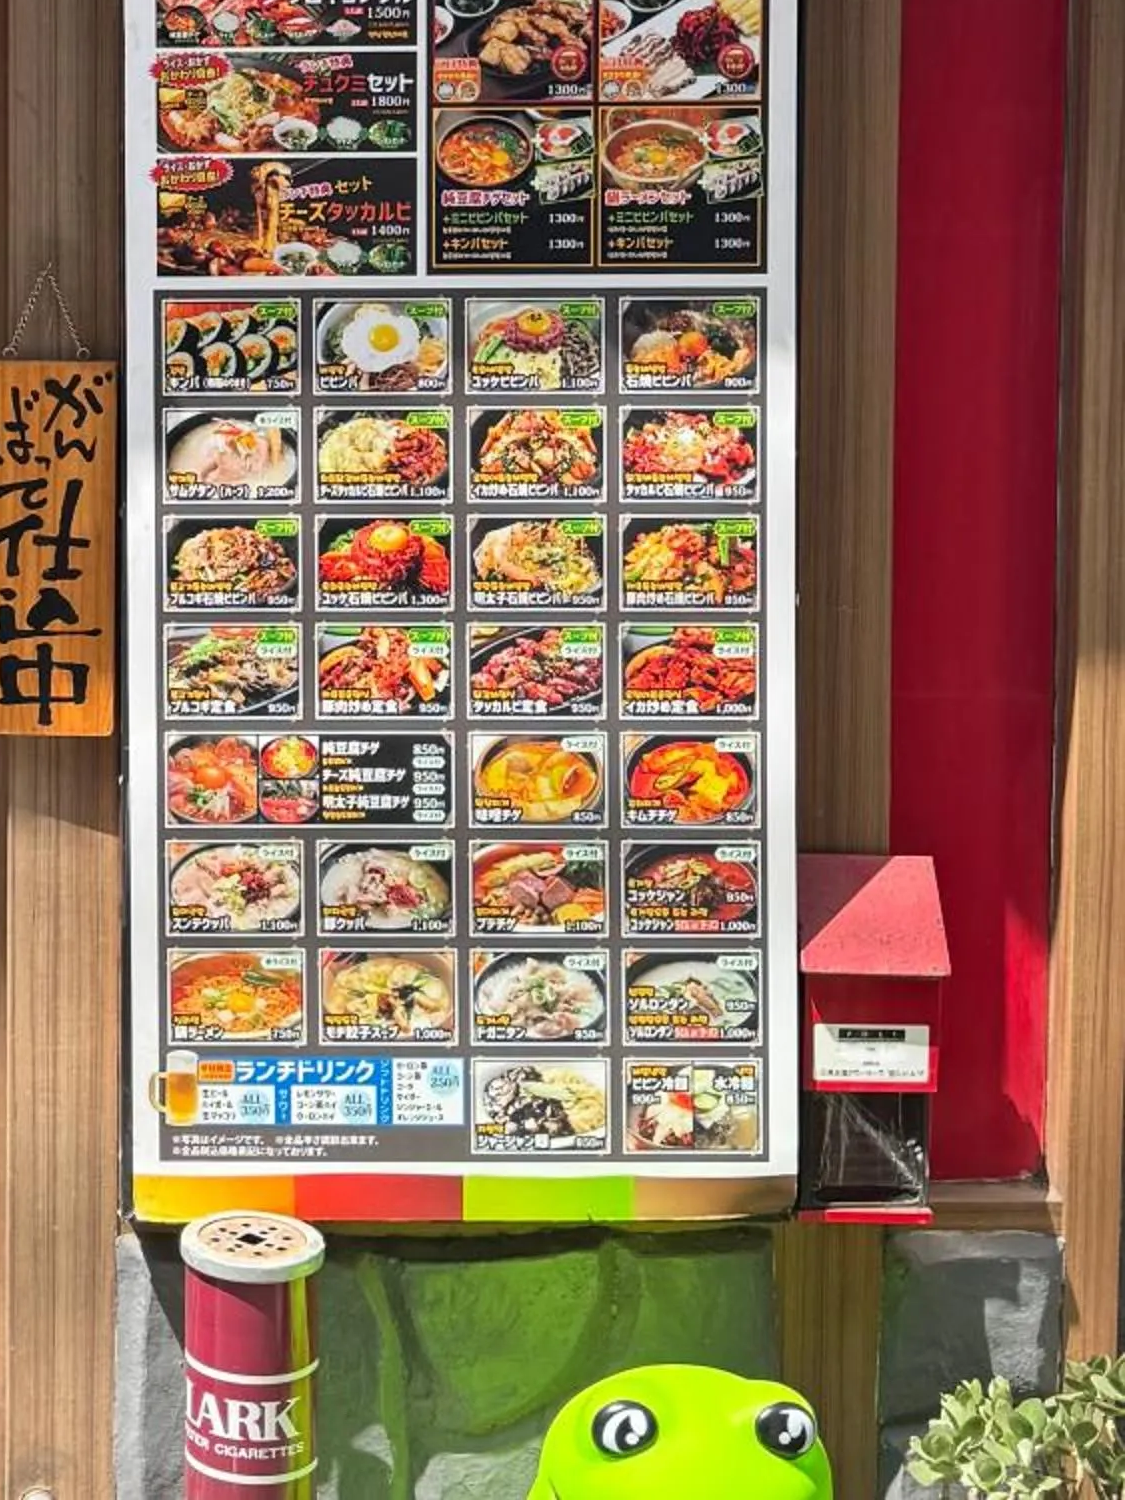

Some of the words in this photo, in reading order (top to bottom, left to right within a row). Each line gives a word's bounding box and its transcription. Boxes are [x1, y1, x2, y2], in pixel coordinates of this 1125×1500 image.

[367, 6, 411, 19] 1500円
[371, 95, 410, 108] 1800円
[334, 176, 373, 193] セット
[279, 202, 412, 223] チーズタッカルビ
[234, 1059, 375, 1083] ランチドリンク
[186, 1376, 301, 1442] LARK
